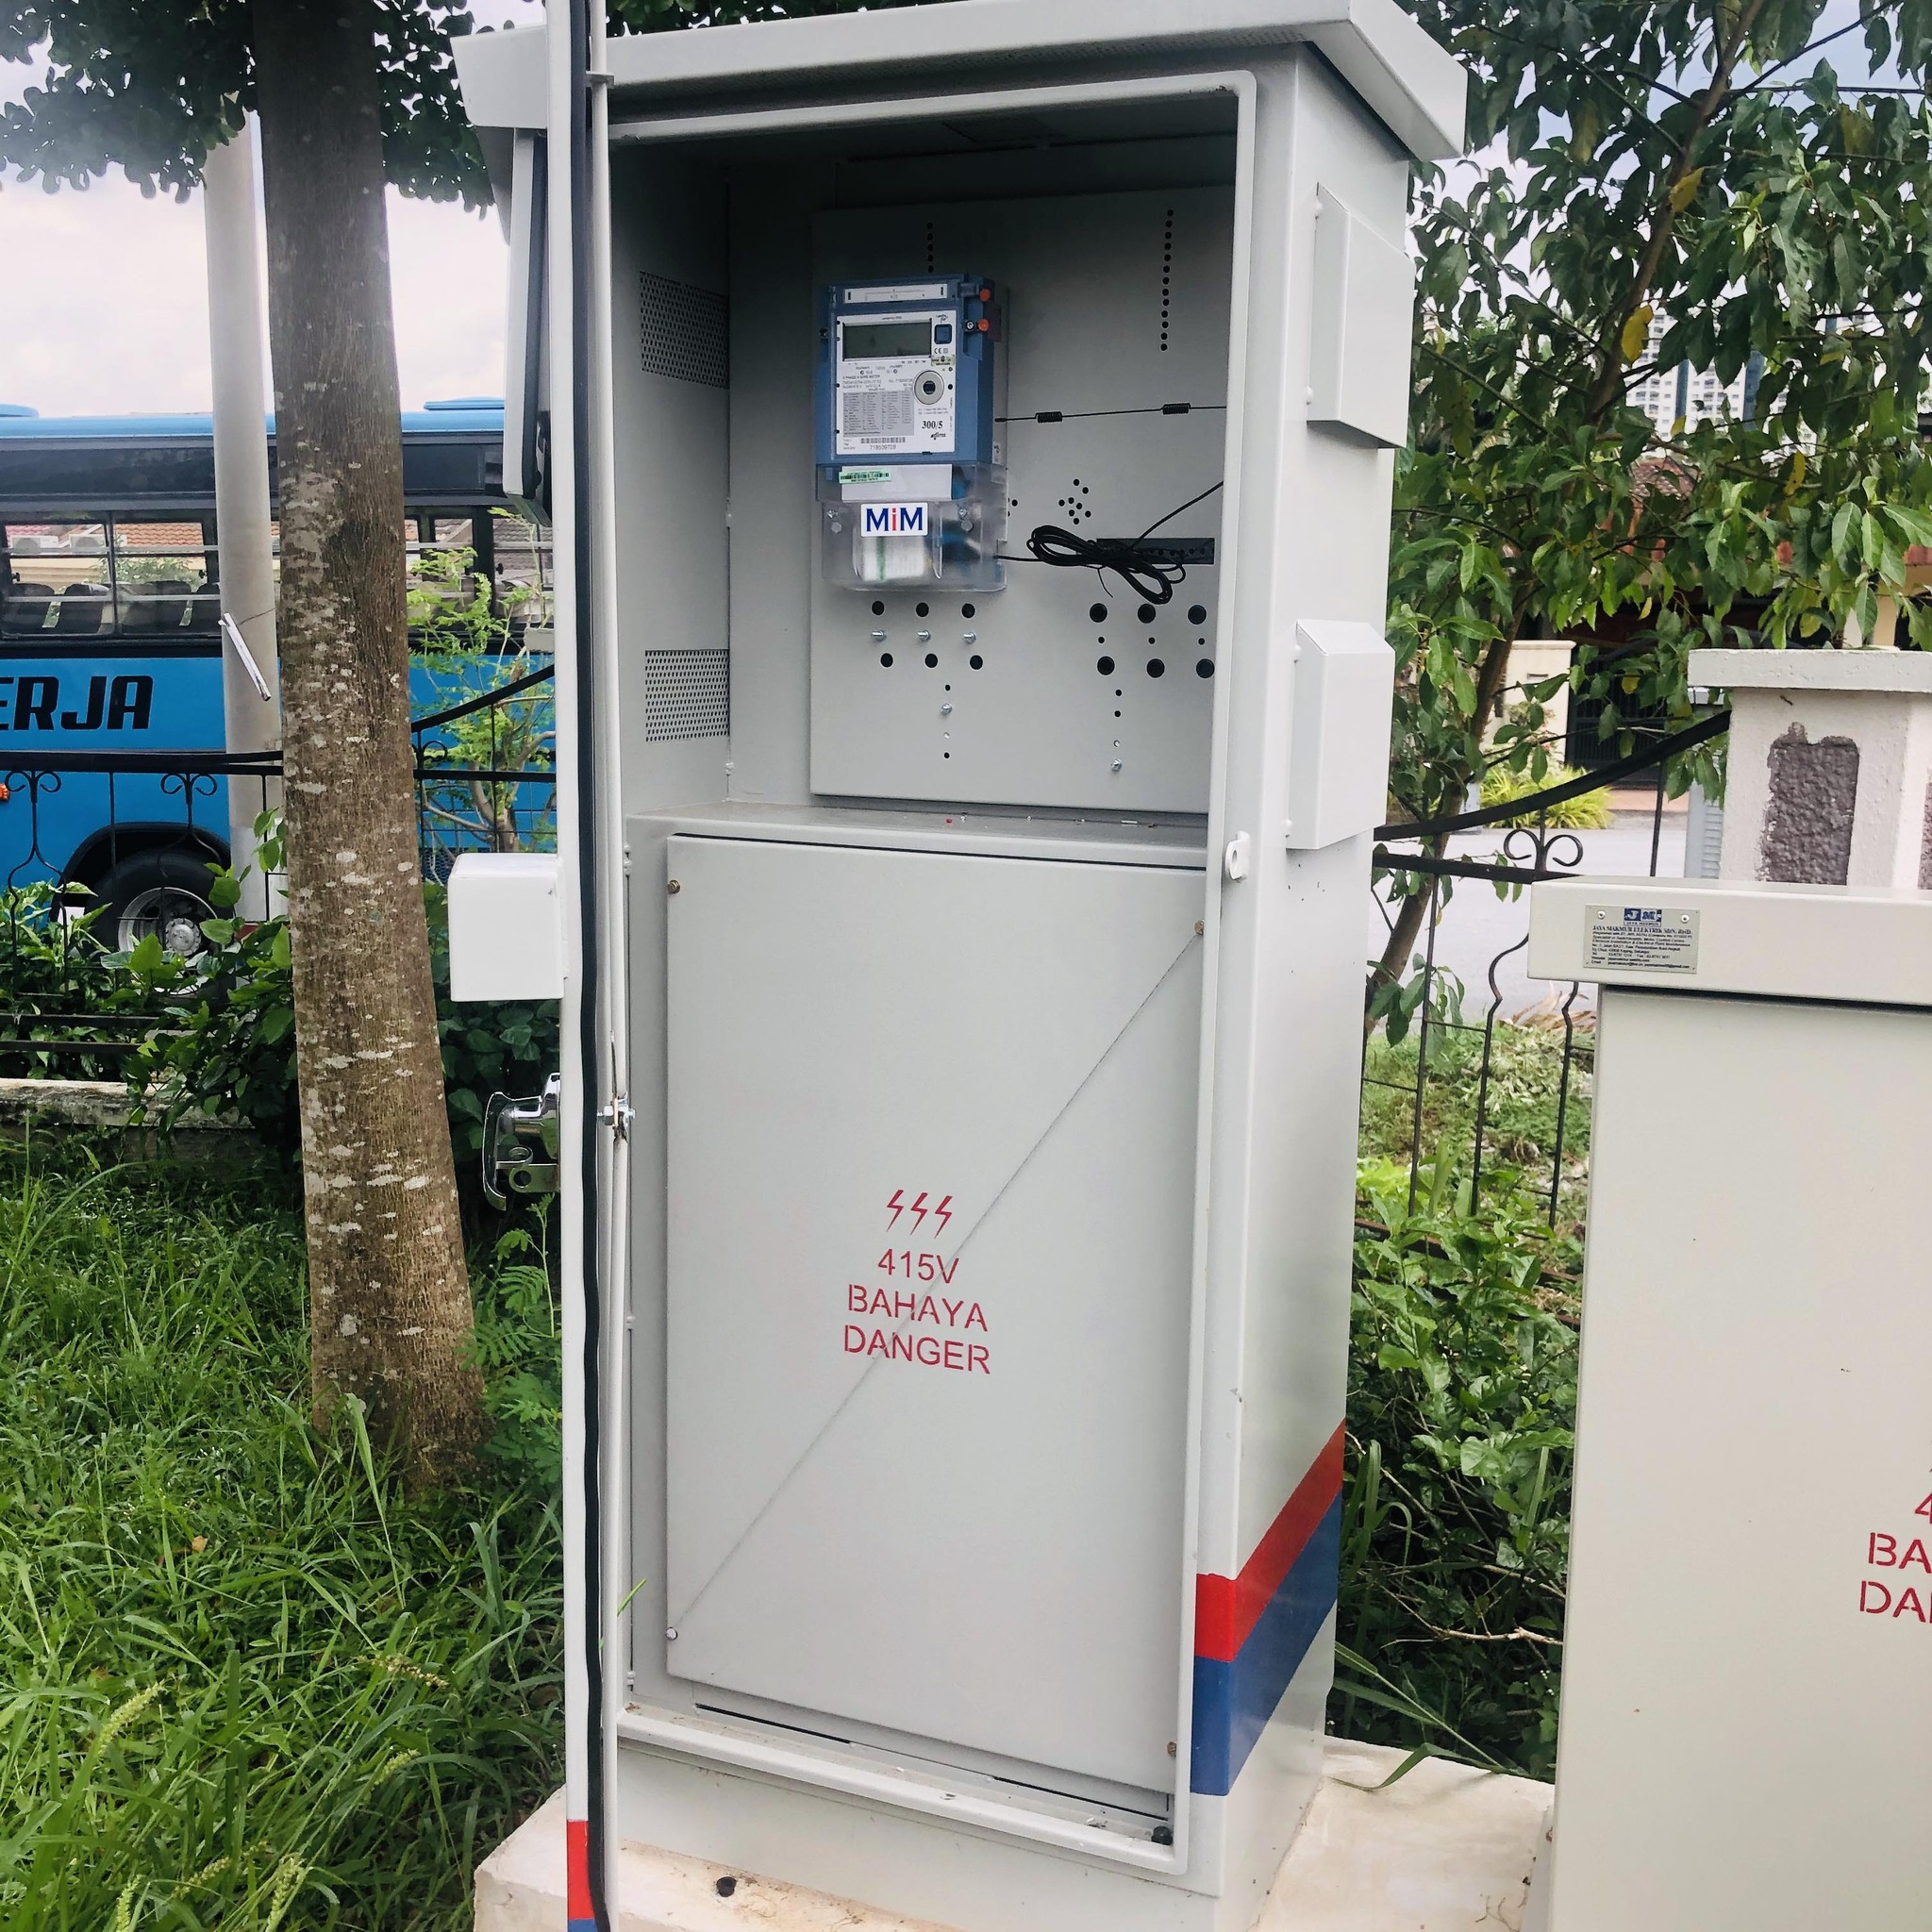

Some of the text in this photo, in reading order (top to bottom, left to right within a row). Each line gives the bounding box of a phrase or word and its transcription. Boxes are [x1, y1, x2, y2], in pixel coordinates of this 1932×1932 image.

[922, 420, 943, 430] 300/5
[866, 507, 924, 533] MiM
[877, 1248, 959, 1284] 415V
[848, 1284, 988, 1332] BAHAYA
[844, 1324, 991, 1374] DANGER
[1859, 1580, 1932, 1624] DA
